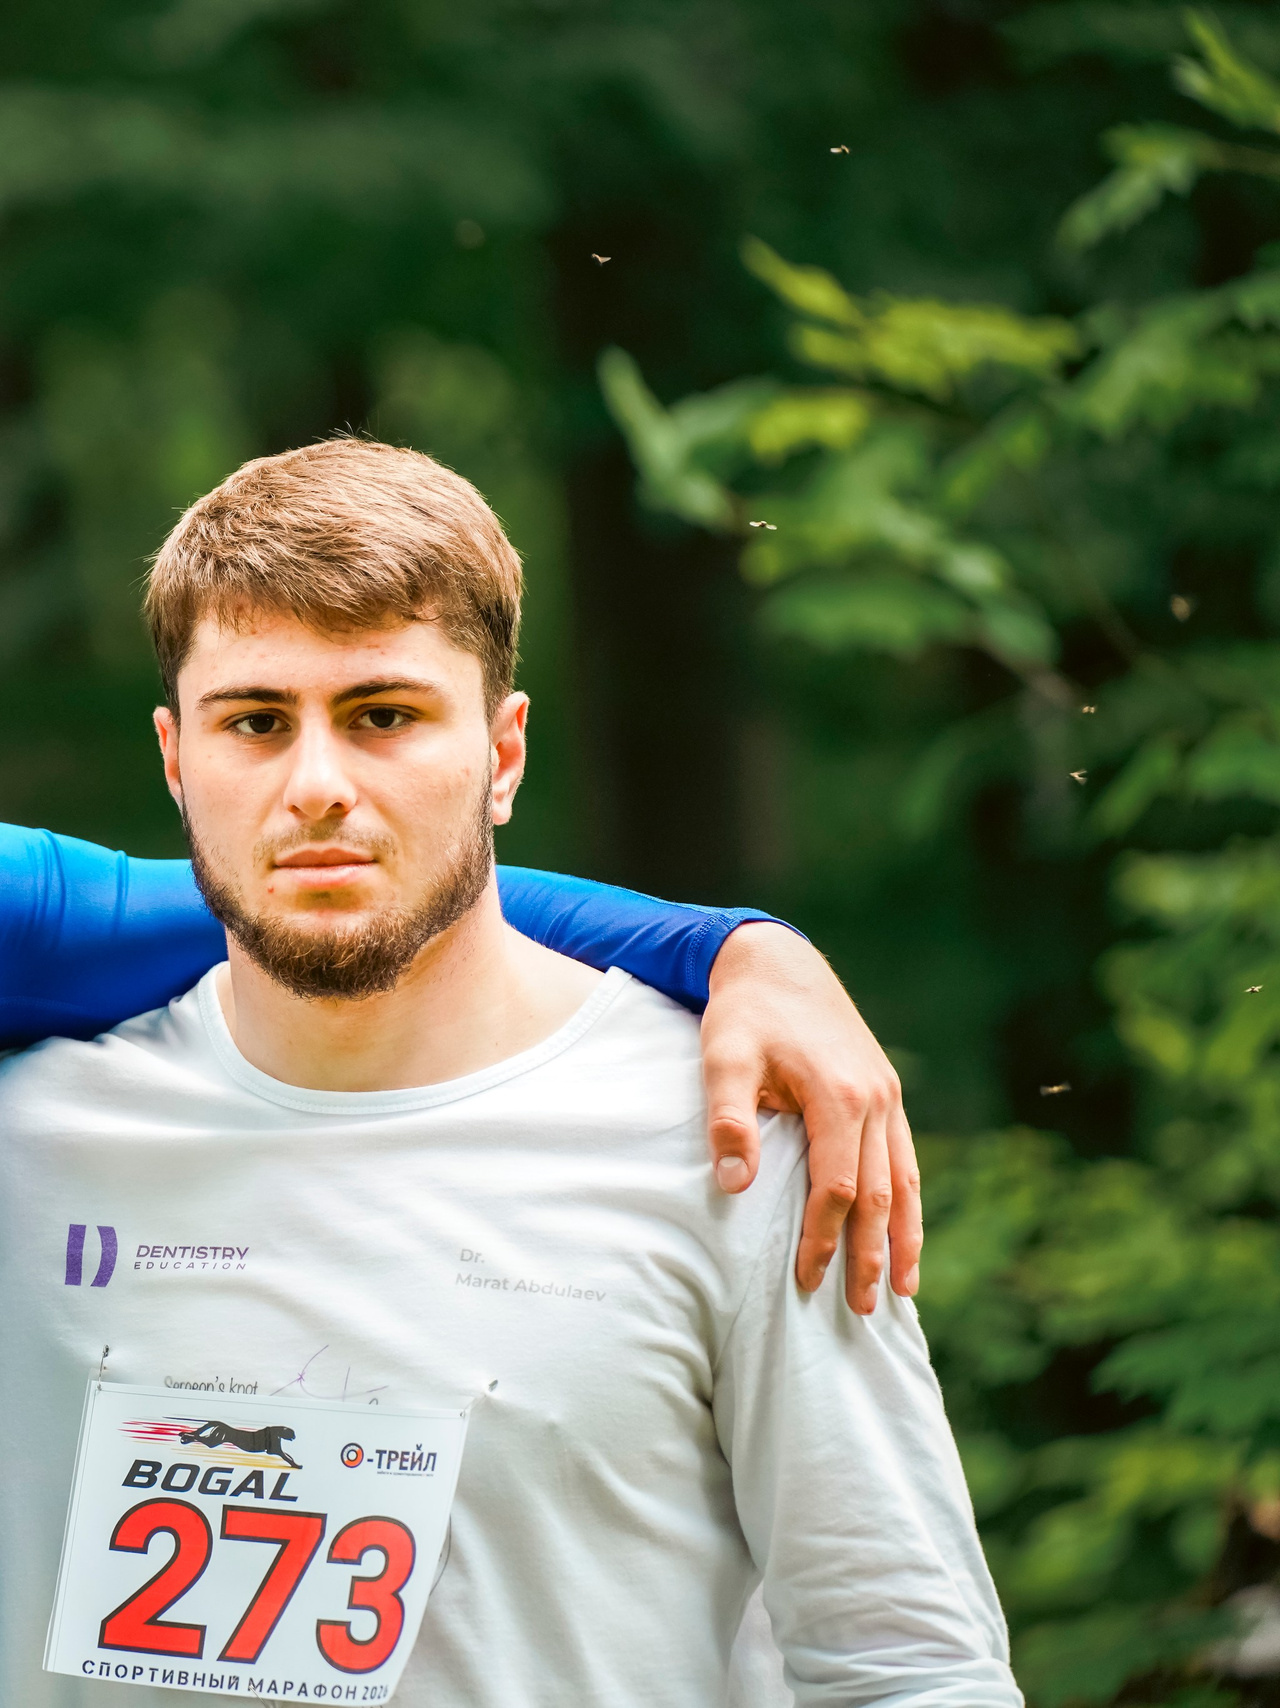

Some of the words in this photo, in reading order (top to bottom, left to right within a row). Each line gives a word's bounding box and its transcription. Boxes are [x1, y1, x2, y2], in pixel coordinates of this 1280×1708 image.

[136, 1245, 249, 1260] DENTISTRY
[460, 1248, 485, 1264] Dr.
[134, 1261, 247, 1270] EDUCATION
[455, 1273, 509, 1291] Marat
[514, 1279, 607, 1302] Abdulaev
[229, 1377, 258, 1395] knot
[122, 1459, 300, 1502] BOGAL
[97, 1496, 417, 1674] 273
[82, 1660, 240, 1691] СПОРТИВНЫЙ
[248, 1677, 357, 1700] МАРАФОН
